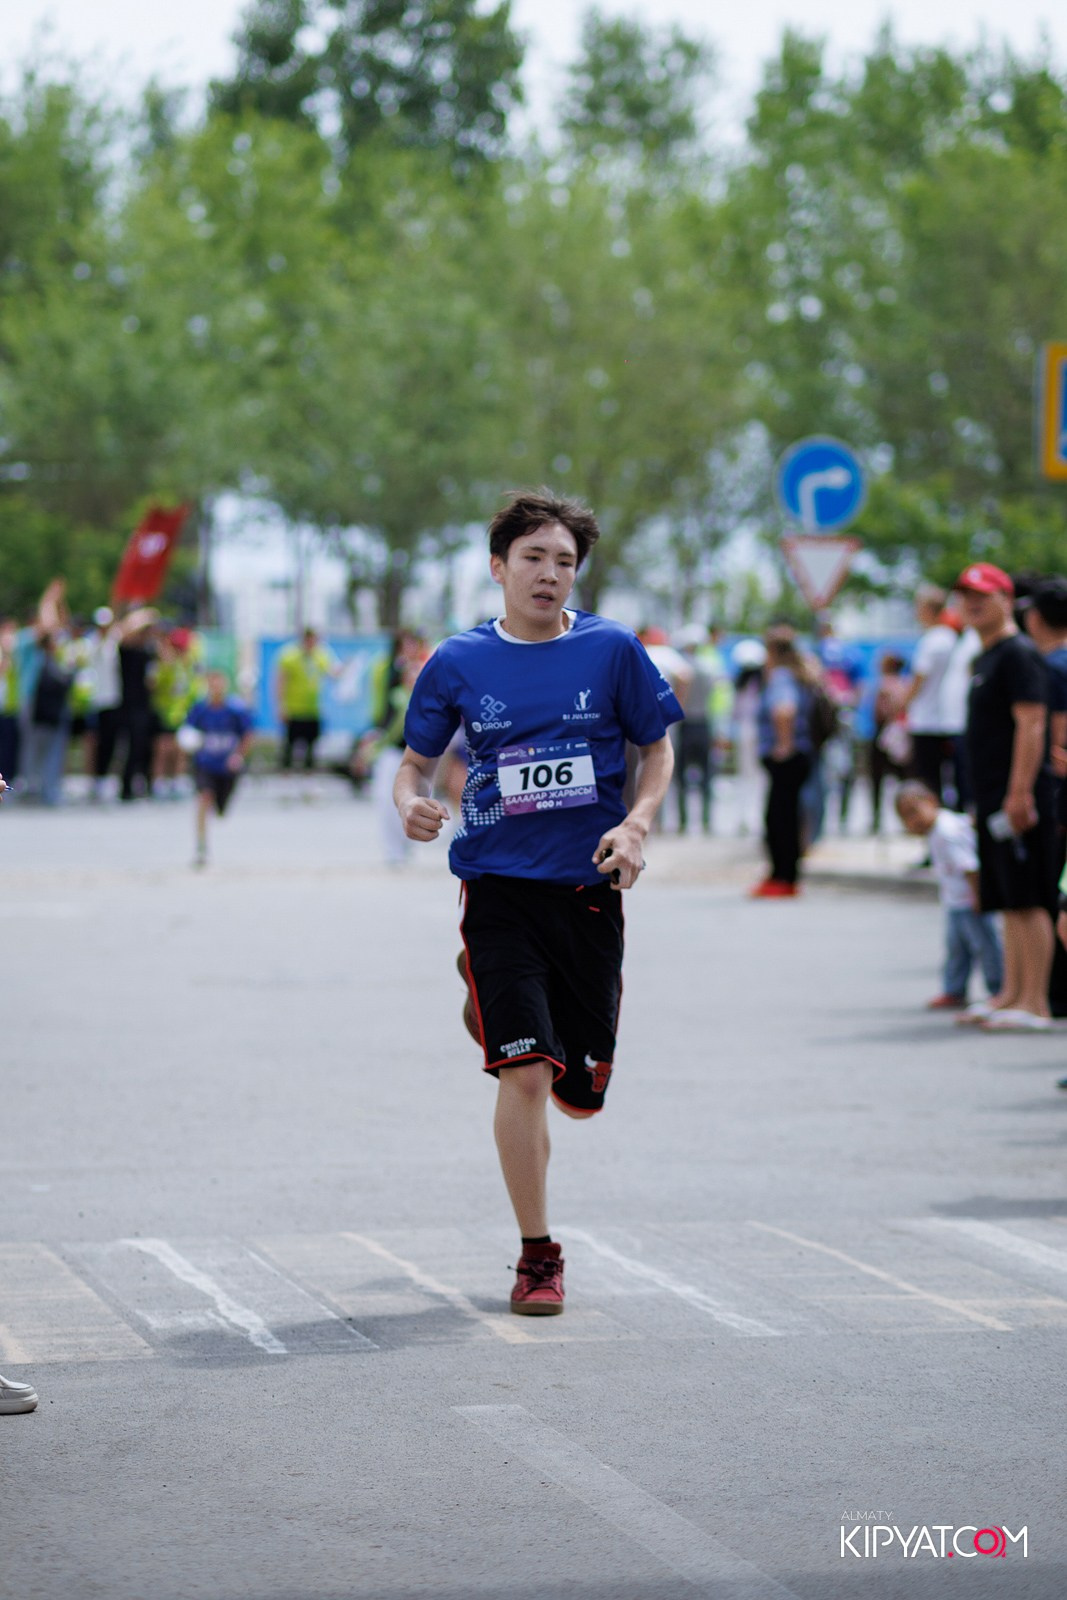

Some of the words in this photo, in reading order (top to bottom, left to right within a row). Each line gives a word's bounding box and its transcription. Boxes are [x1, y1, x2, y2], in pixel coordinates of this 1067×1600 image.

[482, 720, 512, 730] GROUP
[519, 761, 573, 791] 106
[505, 792, 548, 805] БАЛАЛАР
[549, 786, 593, 798] ЖАРЫСЫ
[536, 800, 555, 809] 600
[500, 1037, 537, 1053] CHICAGO
[507, 1044, 531, 1058] BULLS
